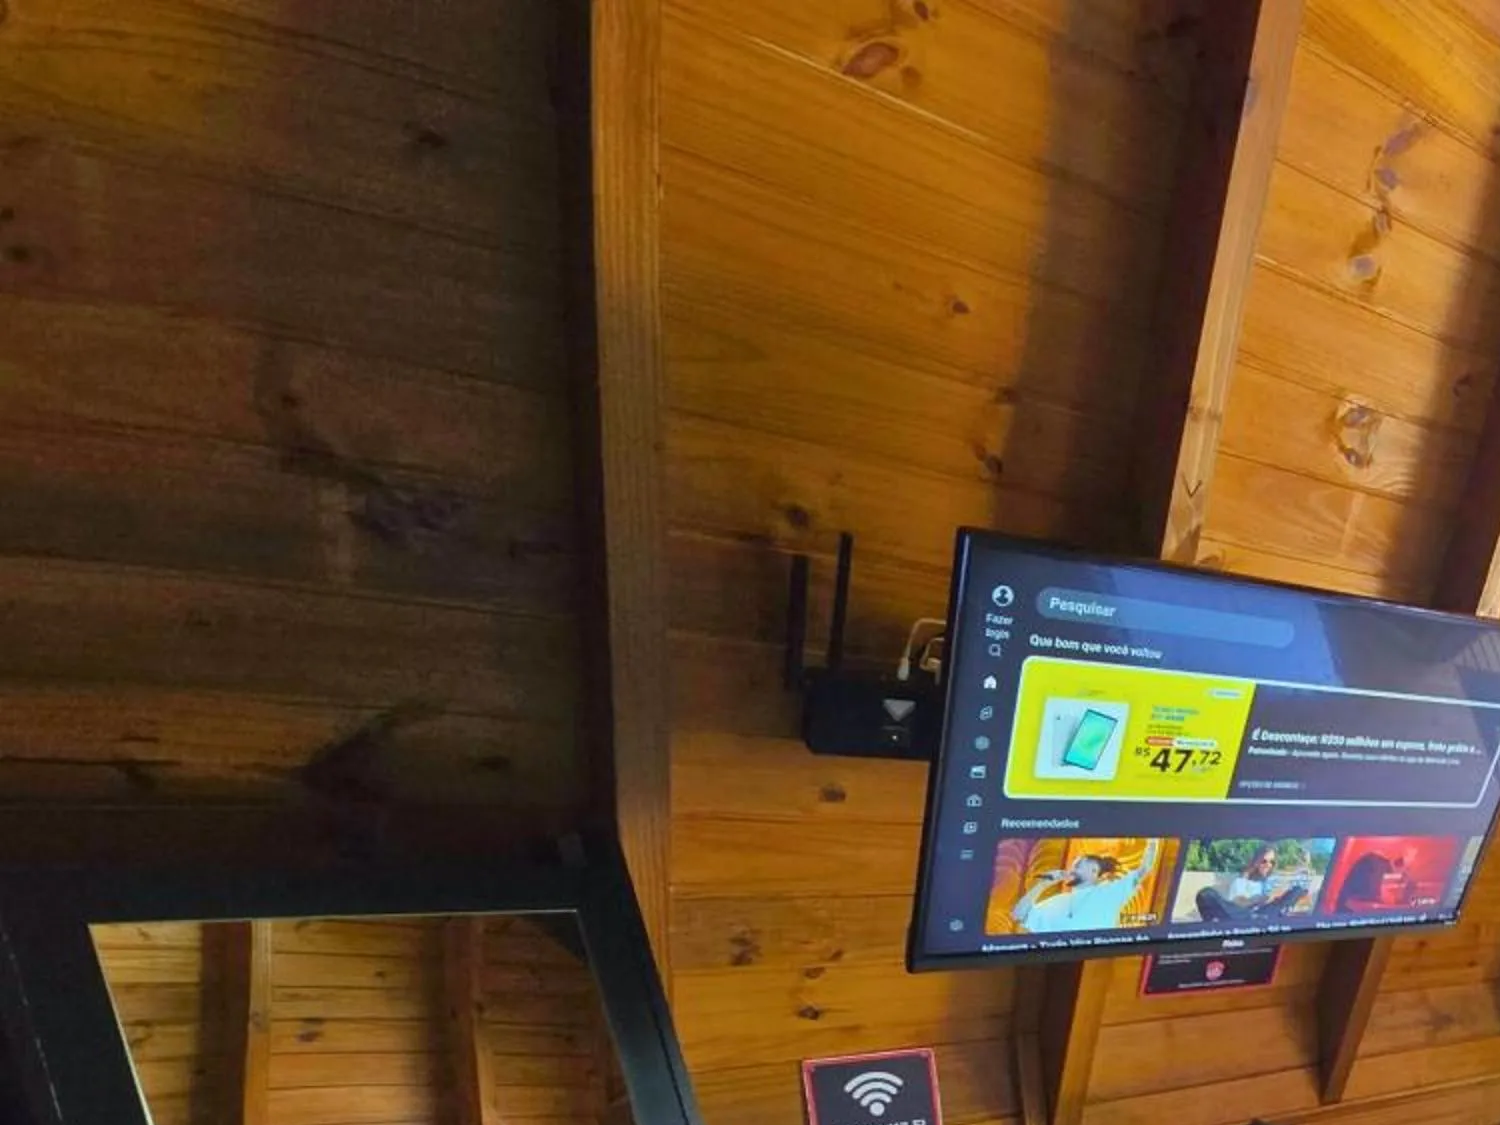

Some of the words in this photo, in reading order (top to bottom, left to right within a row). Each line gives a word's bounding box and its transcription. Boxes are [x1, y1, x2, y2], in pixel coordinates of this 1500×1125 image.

[1050, 597, 1117, 617] Pesquisar
[985, 613, 1013, 625] Fazer
[985, 628, 1010, 640] login
[1029, 634, 1051, 648] Que
[1055, 636, 1079, 651] bom
[1081, 641, 1102, 656] que
[1104, 642, 1128, 656] você
[1131, 647, 1163, 660] voltou
[1135, 747, 1151, 757] R$
[1001, 818, 1080, 830] Recomendados
